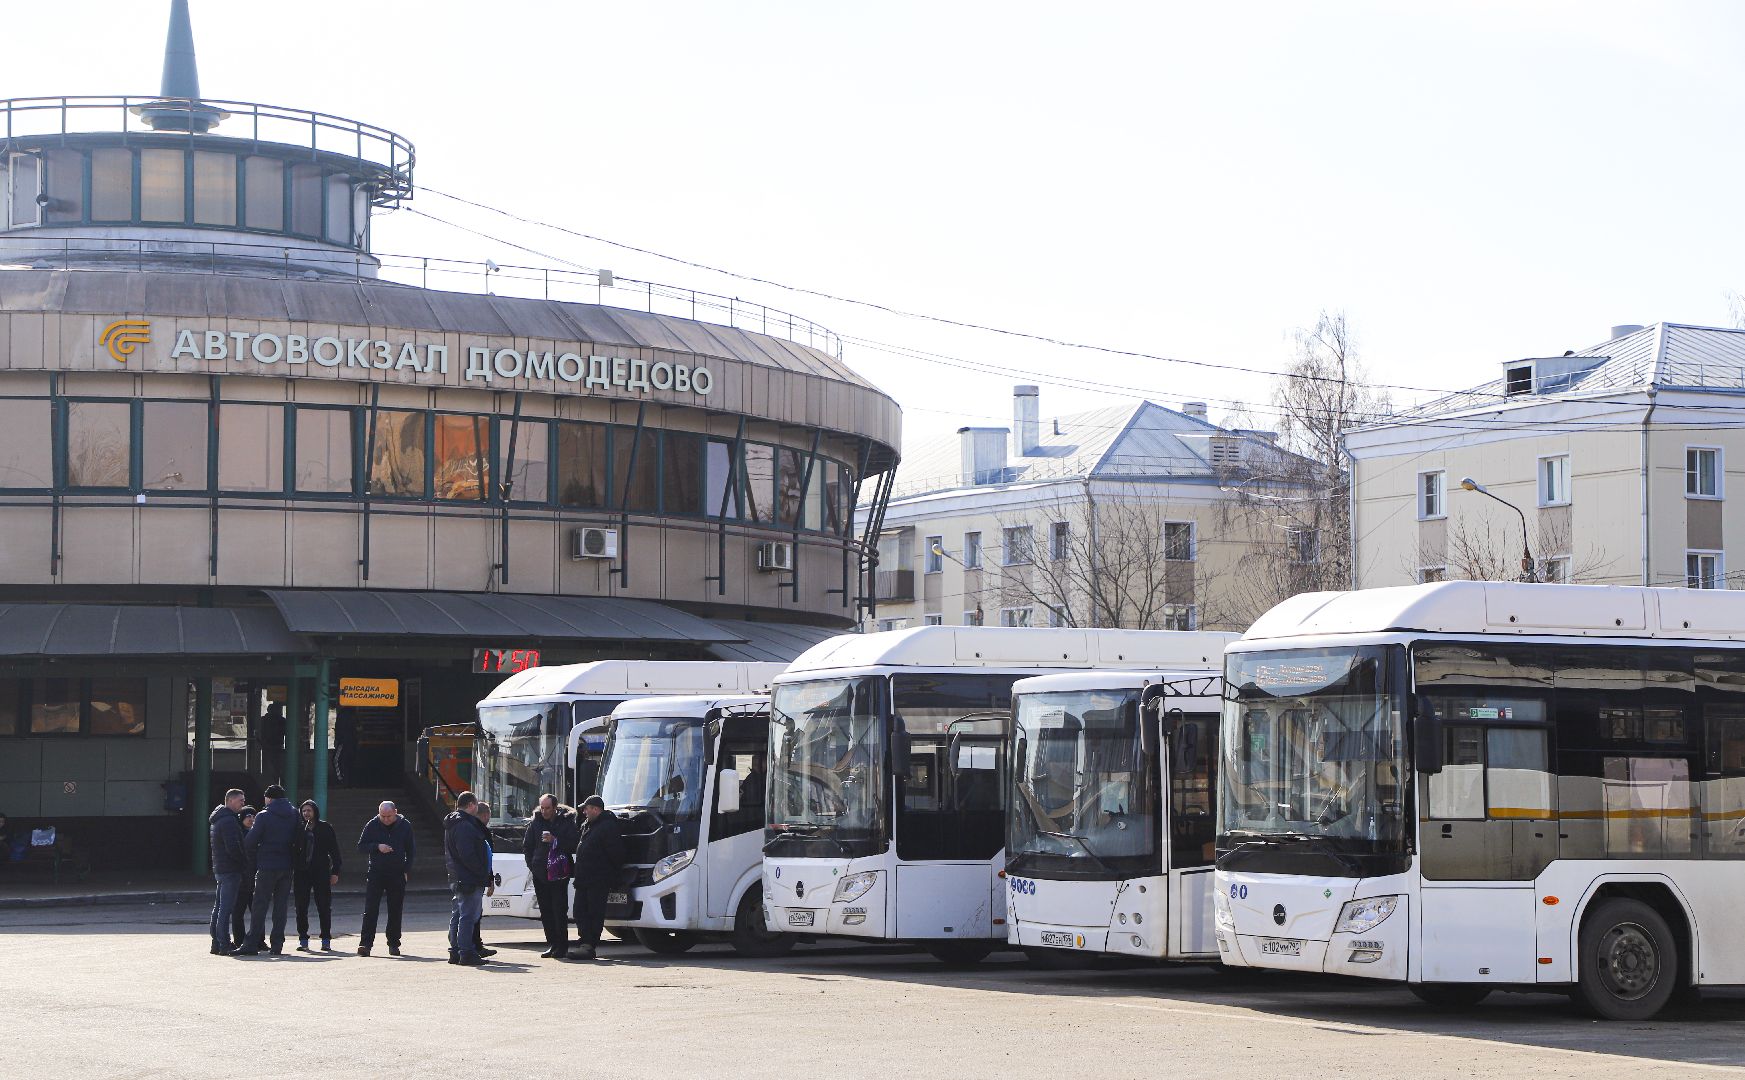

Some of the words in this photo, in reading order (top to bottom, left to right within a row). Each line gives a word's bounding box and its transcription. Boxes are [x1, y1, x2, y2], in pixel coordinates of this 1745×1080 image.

[171, 329, 448, 374] АВТОВОКЗАЛ
[465, 346, 713, 395] ДОМОДЕДОВО
[343, 692, 395, 700] ПАССАЖИРОВ
